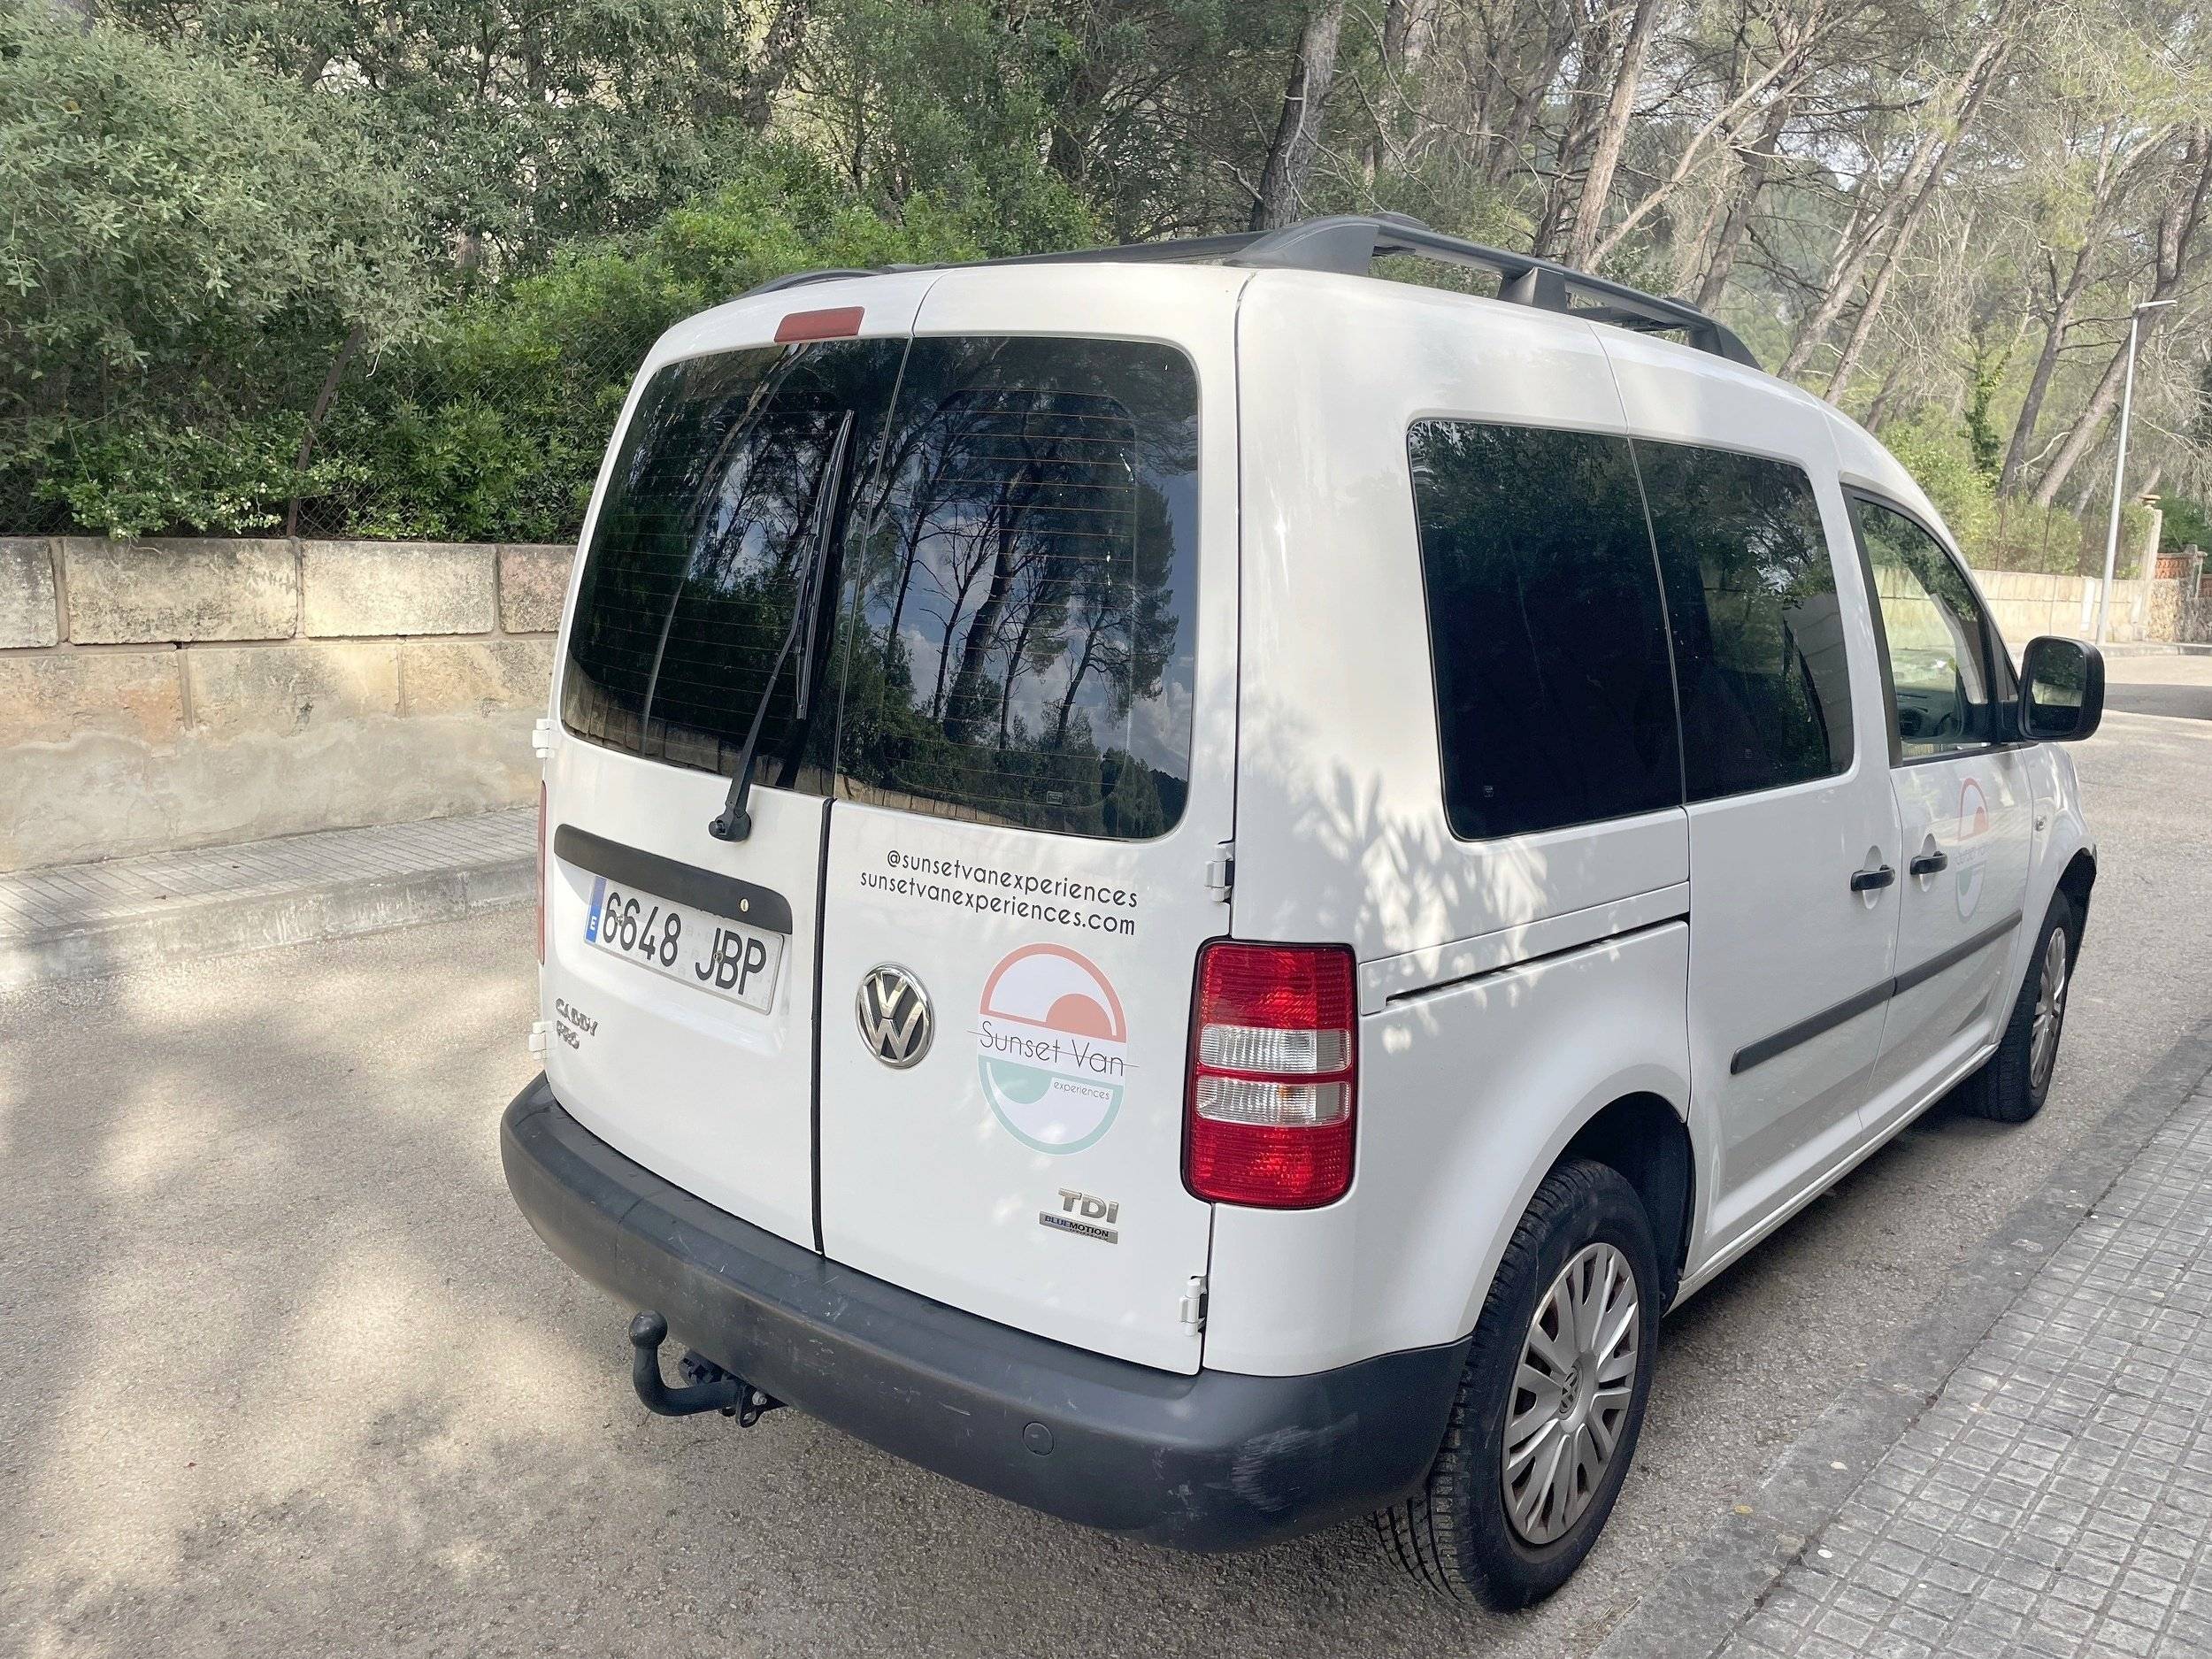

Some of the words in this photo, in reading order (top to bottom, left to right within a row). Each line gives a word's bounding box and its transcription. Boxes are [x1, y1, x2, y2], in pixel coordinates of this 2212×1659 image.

[860, 871, 1135, 935] sunsetvanexperiences.com
[887, 849, 1138, 908] @sunsetvanexperiences
[603, 892, 681, 967] 6648
[695, 927, 767, 995] JBP
[857, 966, 931, 1066] VW
[979, 1020, 1061, 1064] Sunset
[1071, 1039, 1124, 1077] Van
[1053, 1079, 1110, 1101] experiences
[1058, 1187, 1119, 1225] TDI
